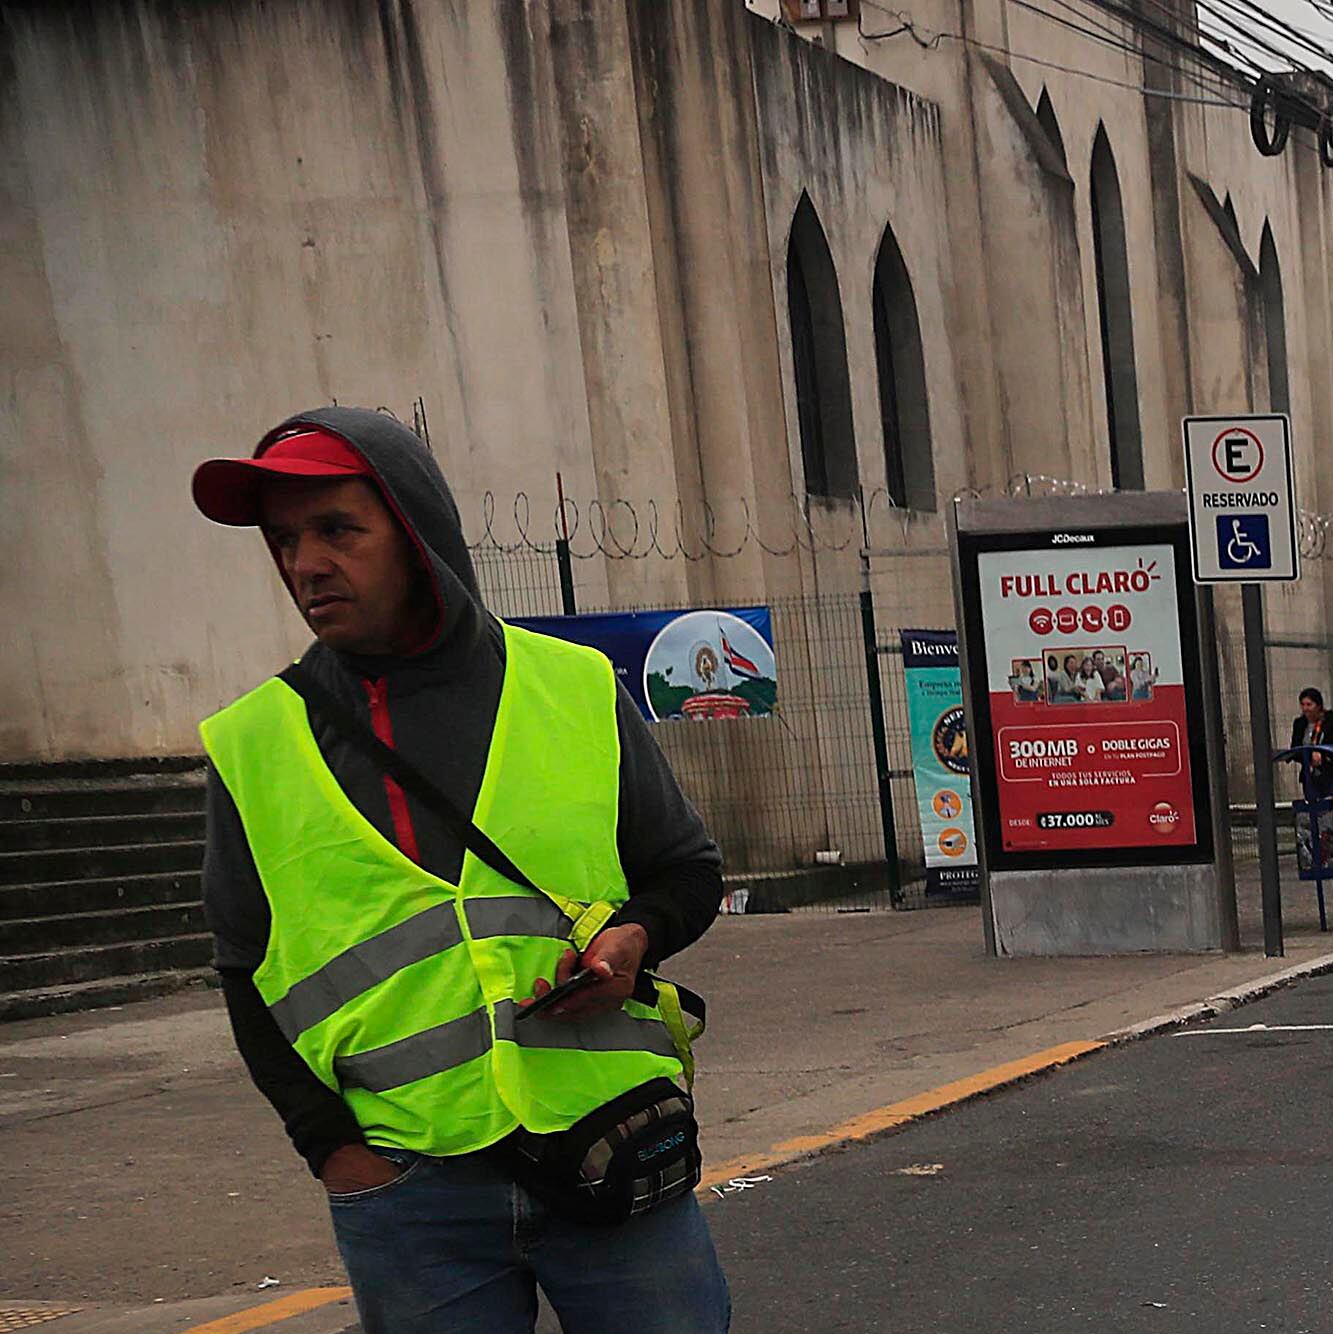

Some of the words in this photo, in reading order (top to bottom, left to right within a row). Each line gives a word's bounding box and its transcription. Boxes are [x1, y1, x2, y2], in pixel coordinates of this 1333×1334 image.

[1225, 438, 1251, 473] E
[1202, 492, 1279, 508] RESERVADO
[1051, 534, 1095, 544] JCDecaux
[1001, 574, 1062, 598] FULL
[1066, 570, 1150, 595] CLARO
[1102, 740, 1136, 751] DOBLE
[1138, 738, 1170, 750] GIGAS
[1015, 759, 1029, 768] DE
[1029, 757, 1072, 768] INTERNET
[1052, 772, 1076, 780] TODOS
[1079, 771, 1092, 779] TUS
[1094, 770, 1131, 778] SERVICIOS
[1049, 779, 1059, 787] EN
[1061, 779, 1077, 787] UNA
[1079, 778, 1099, 786] SOLA
[1100, 777, 1136, 785] FACTURA
[1150, 815, 1175, 824] Claro
